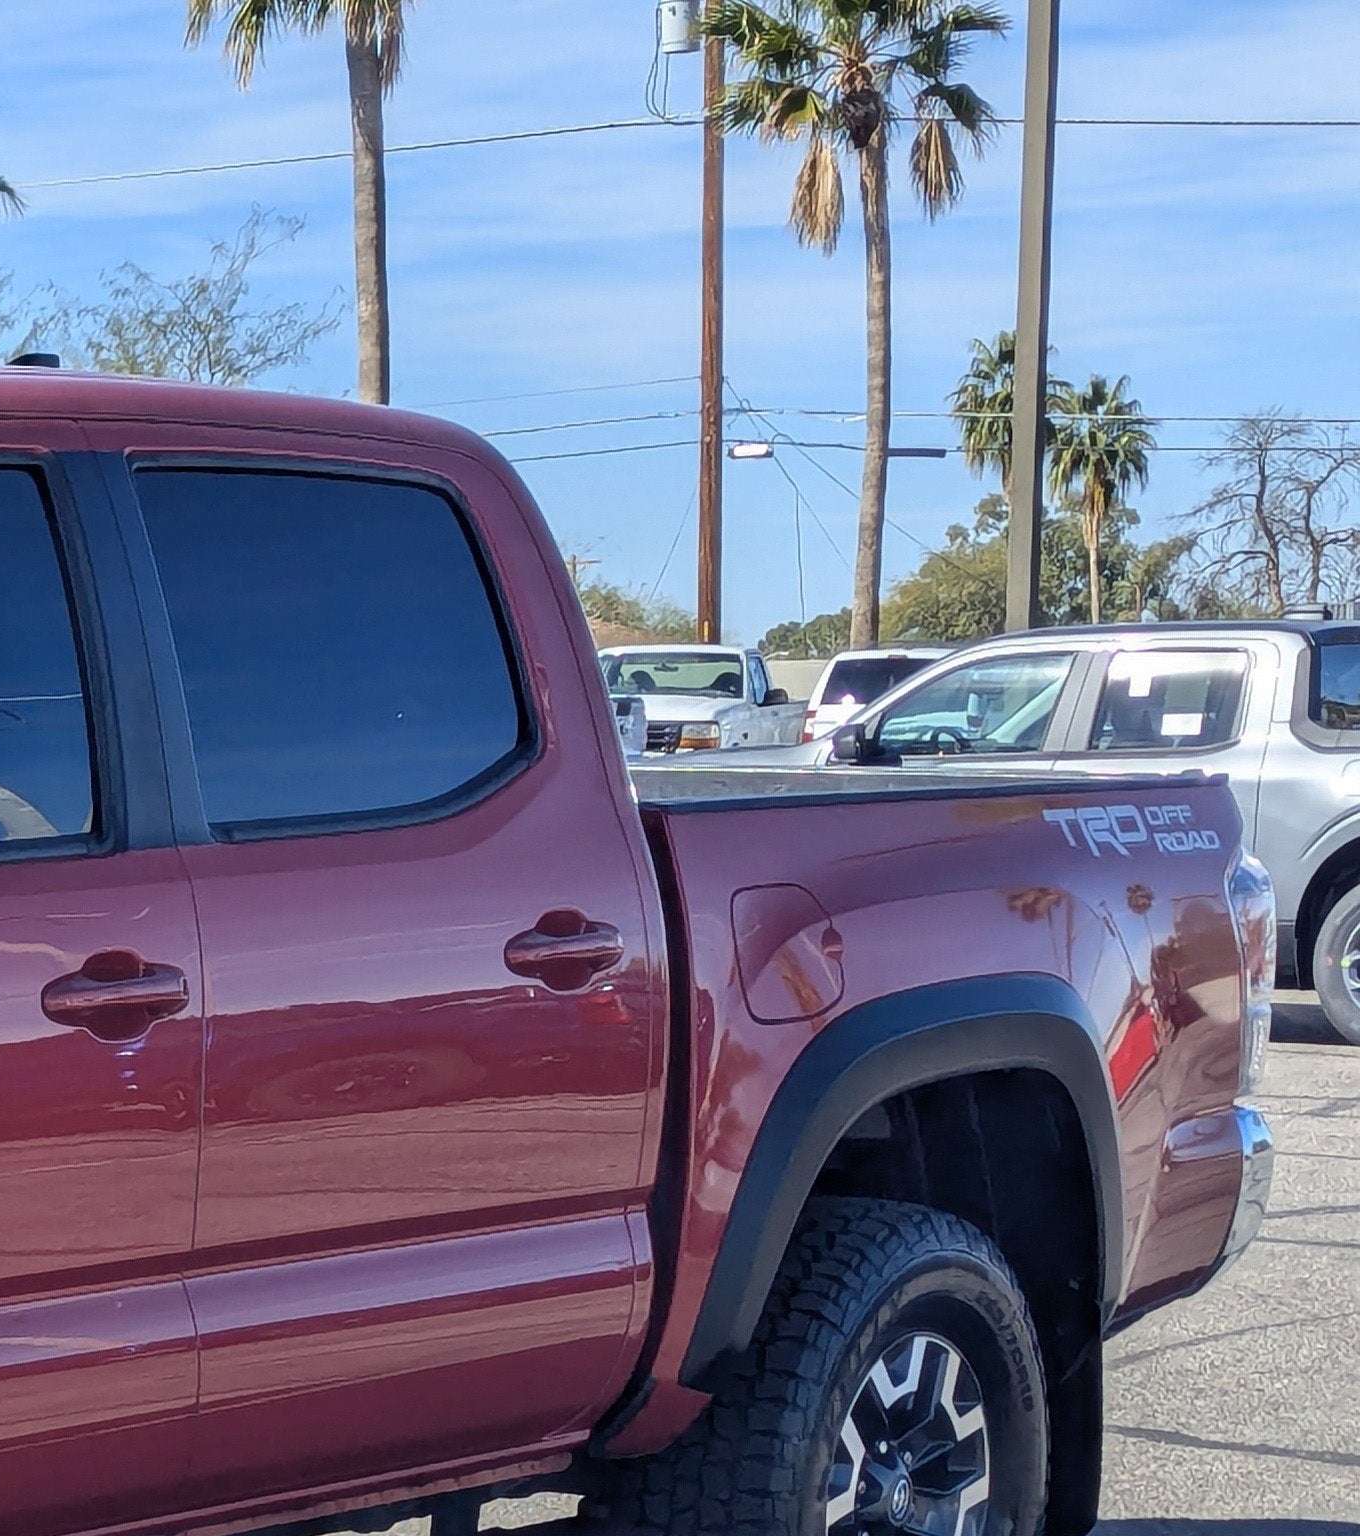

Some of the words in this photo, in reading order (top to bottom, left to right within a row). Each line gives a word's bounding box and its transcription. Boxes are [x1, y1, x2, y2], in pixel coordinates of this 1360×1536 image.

[1042, 804, 1148, 858] TRD
[1144, 804, 1193, 826] OFF
[1153, 830, 1221, 854] ROAD
